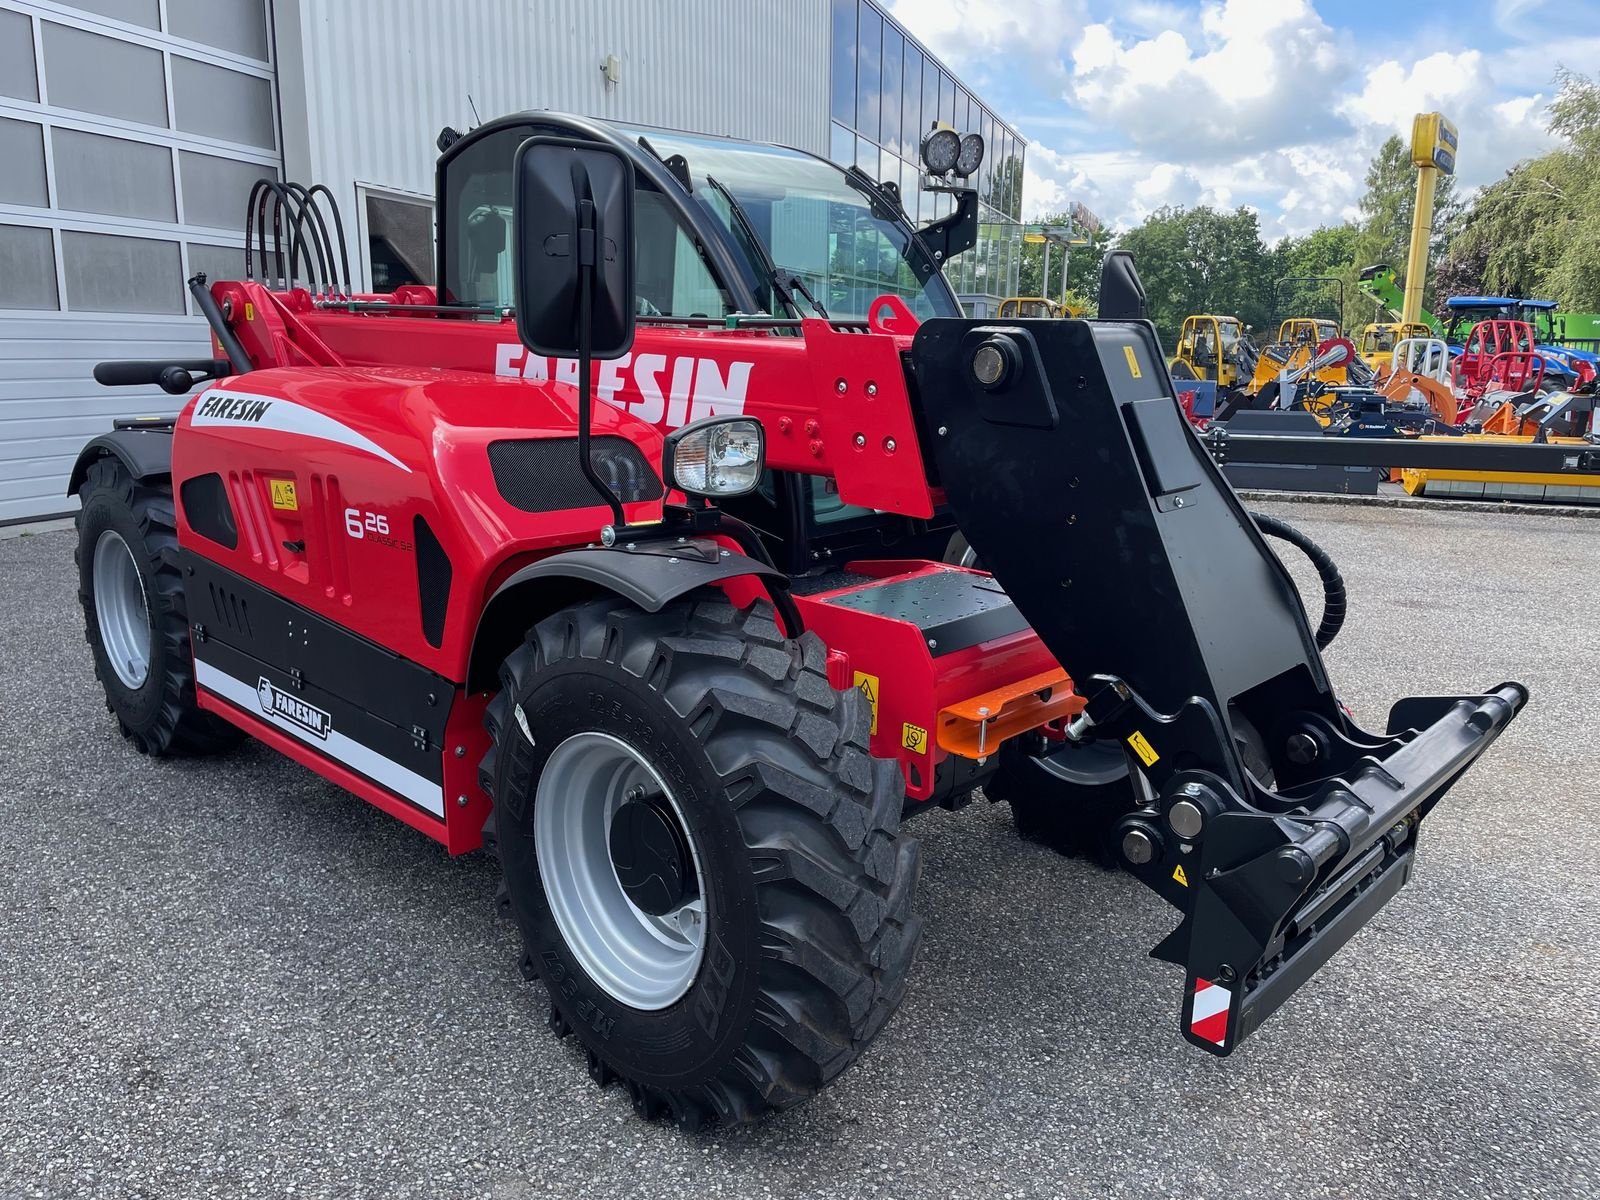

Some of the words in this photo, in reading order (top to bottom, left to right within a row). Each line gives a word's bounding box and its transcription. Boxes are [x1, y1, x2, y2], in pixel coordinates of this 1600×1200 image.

[198, 396, 272, 423] FARESIN
[367, 532, 400, 550] CLASSIC
[275, 692, 322, 731] FARESIN
